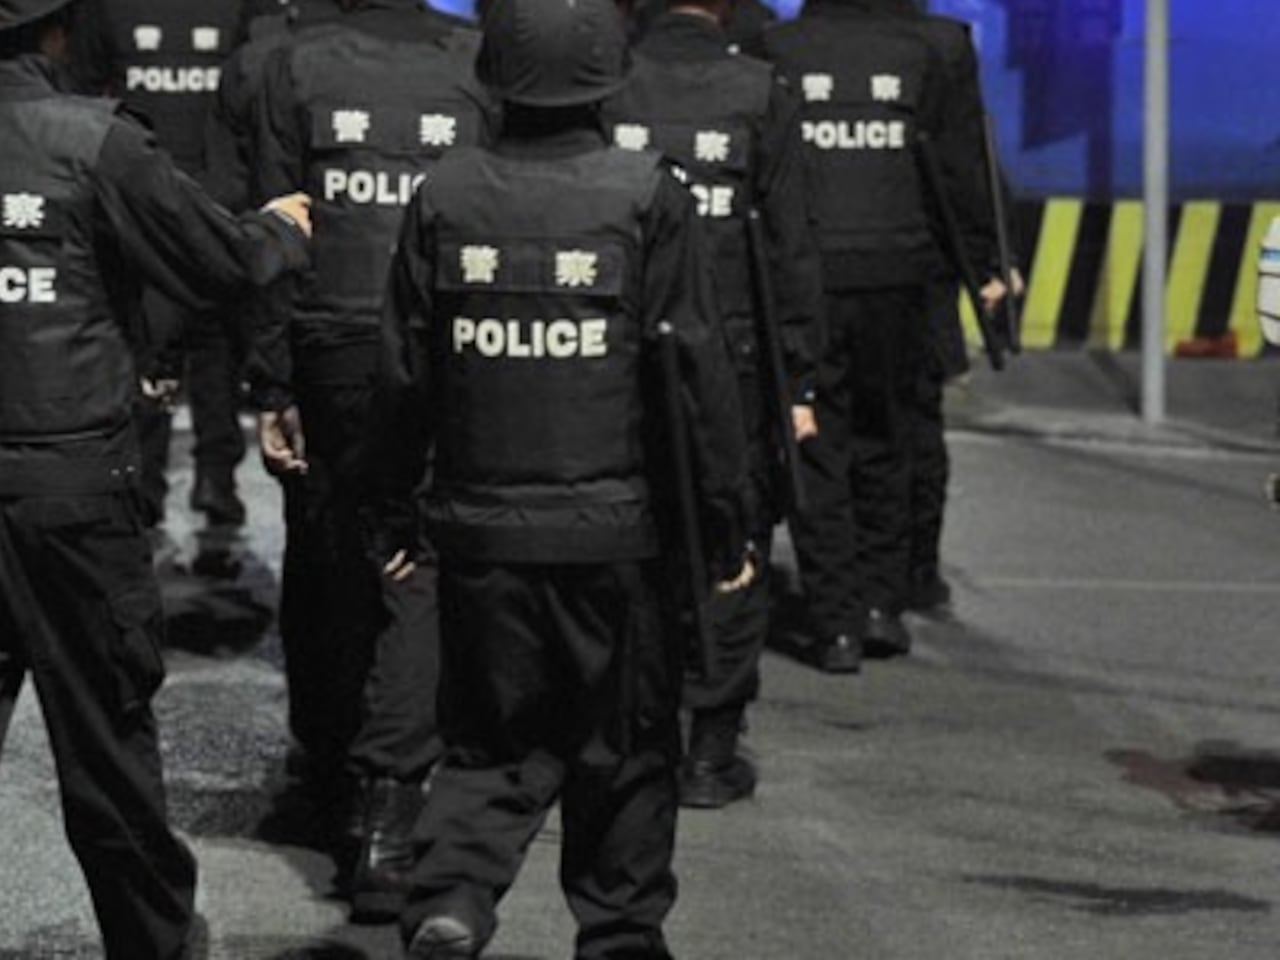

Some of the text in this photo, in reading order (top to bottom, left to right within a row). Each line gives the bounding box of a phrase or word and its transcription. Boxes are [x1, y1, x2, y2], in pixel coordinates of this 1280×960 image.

[127, 66, 221, 91] POLICE
[801, 120, 905, 149] POLICE
[453, 318, 607, 358] POLICE
